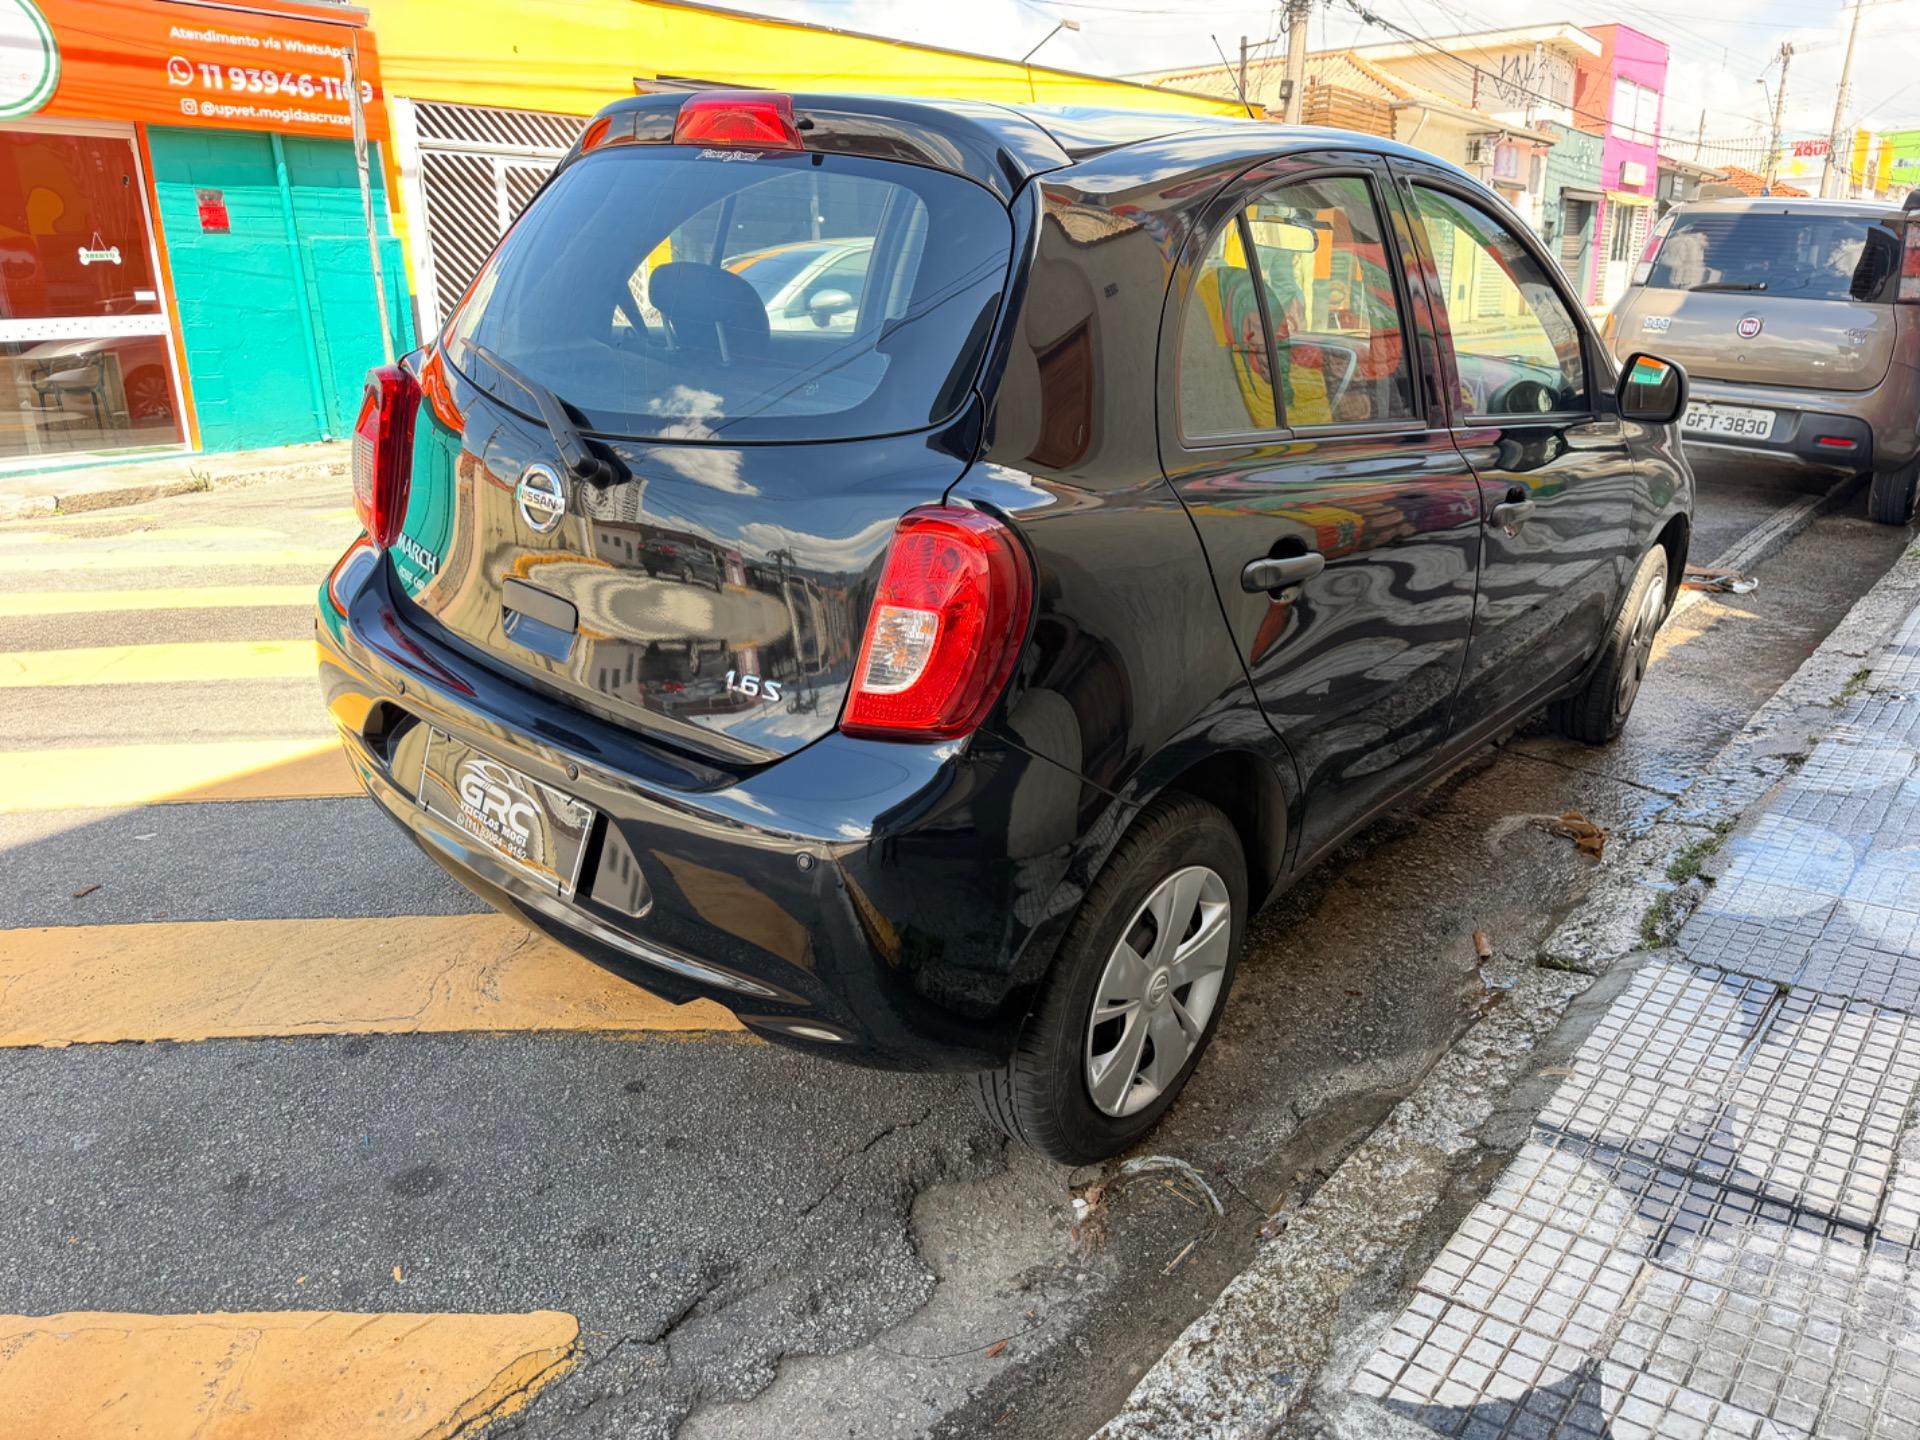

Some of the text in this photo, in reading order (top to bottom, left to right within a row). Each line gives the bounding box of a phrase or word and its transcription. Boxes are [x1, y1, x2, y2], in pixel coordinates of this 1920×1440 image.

[170, 26, 260, 48] Atendimento
[262, 38, 281, 50] via
[198, 63, 373, 104] 11 93946-119
[201, 101, 352, 125] @upvet.mogidascruze
[522, 487, 559, 511] ISSAN
[396, 531, 438, 576] MARCH
[460, 772, 535, 839] GRC
[501, 824, 528, 849] MOGI
